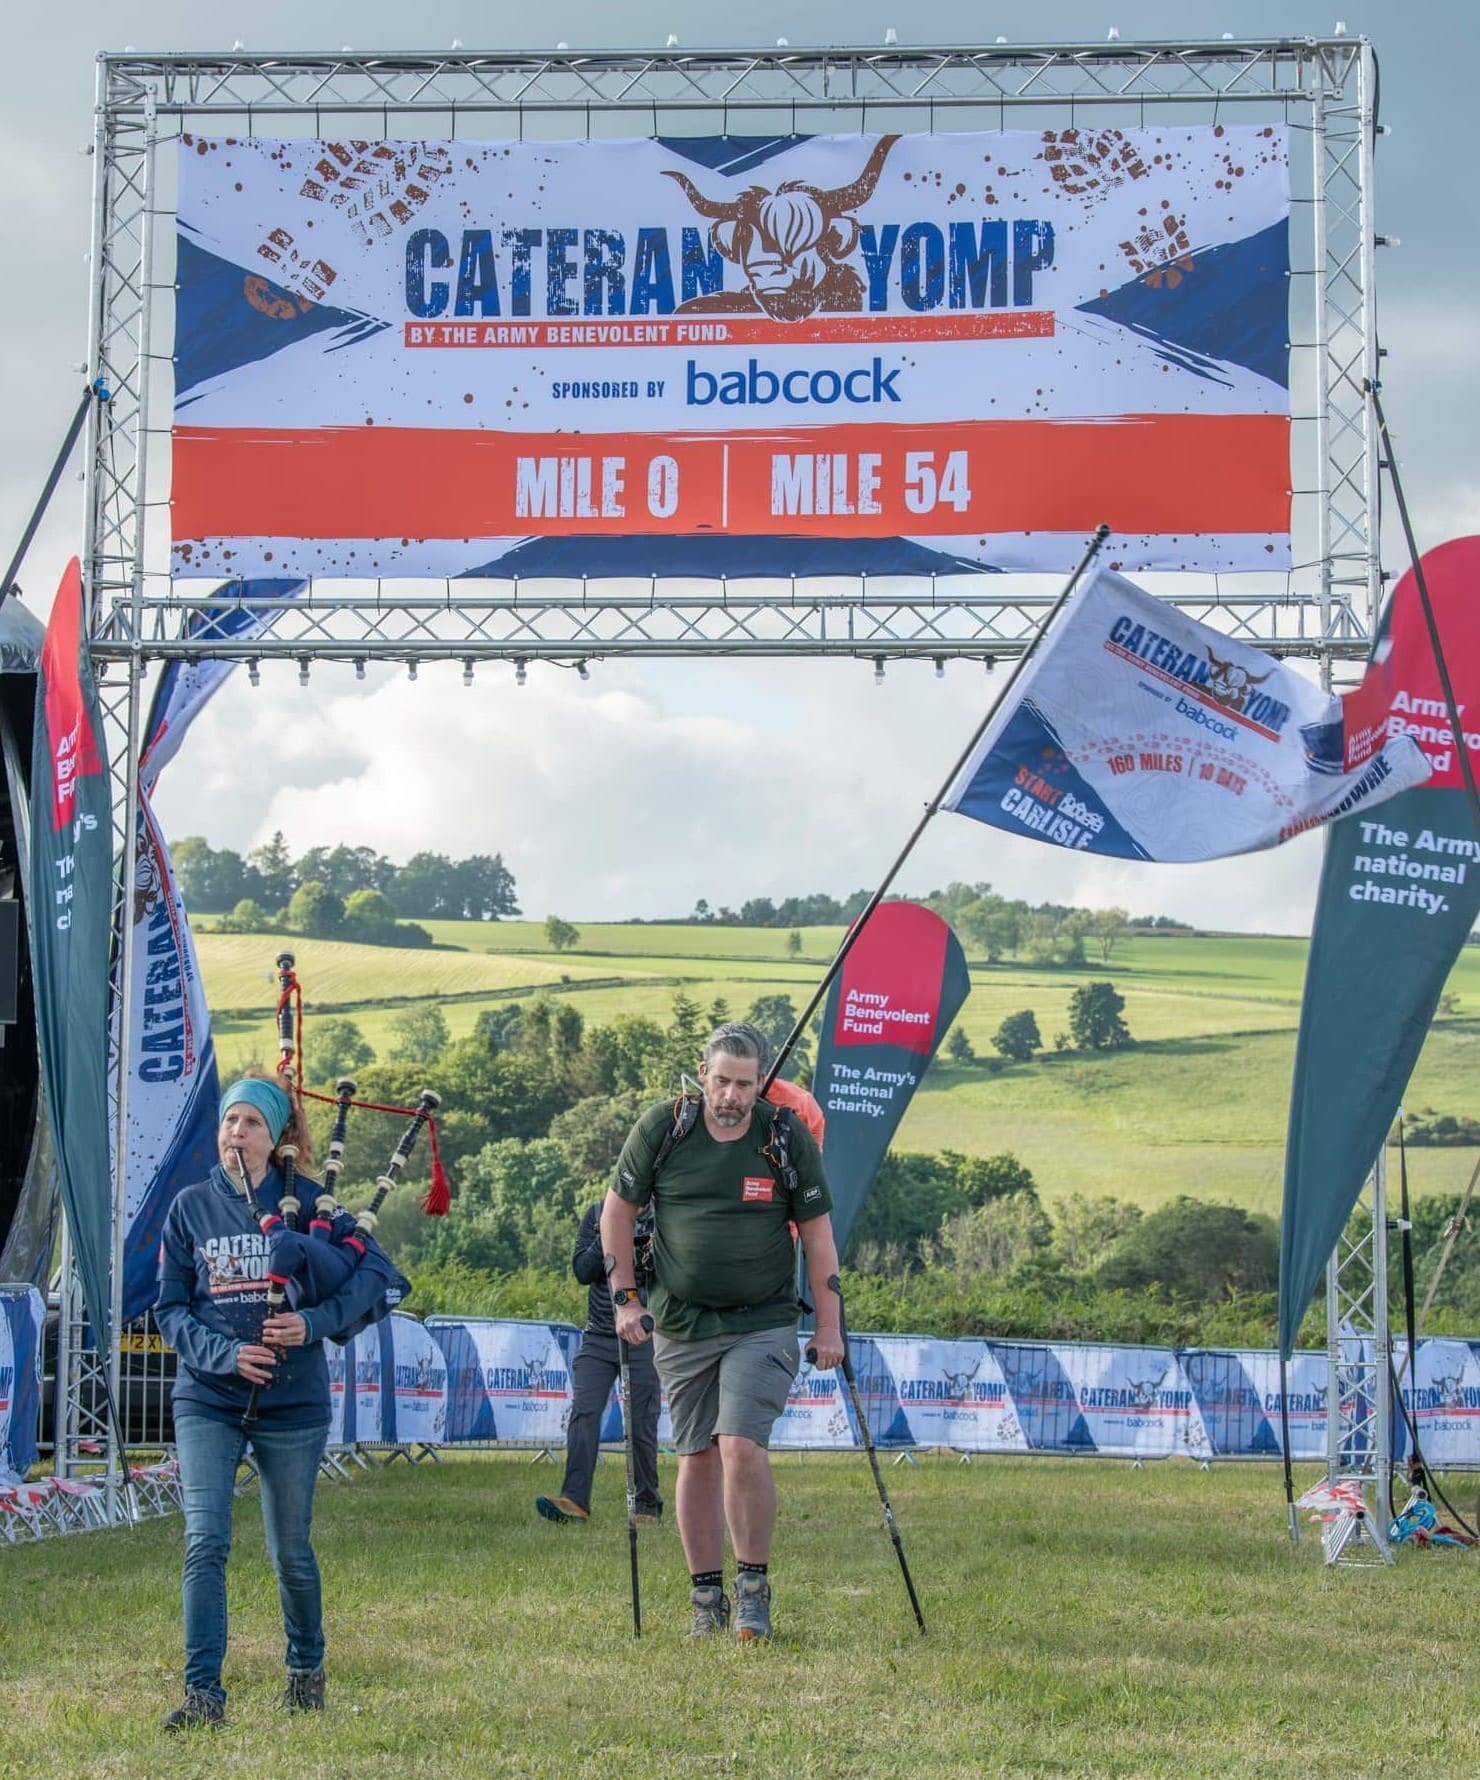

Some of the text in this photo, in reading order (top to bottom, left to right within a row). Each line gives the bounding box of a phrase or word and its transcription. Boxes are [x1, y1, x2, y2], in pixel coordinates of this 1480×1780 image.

[406, 219, 1054, 318] CATERAN YOMP
[411, 324, 727, 343] BY THE ARMY BENEVOLENT FUND
[552, 380, 665, 399] SPONSORED BY
[686, 357, 901, 405] babcock
[515, 454, 679, 518] MILE 0
[771, 450, 971, 516] MILE 54
[1109, 615, 1210, 684] CATERAN
[1175, 698, 1239, 741] babcock
[1108, 752, 1182, 776] 160 MILES
[1200, 763, 1213, 780] 10
[1014, 768, 1063, 805] START
[1000, 788, 1094, 849] CARLISLE
[1360, 822, 1408, 847] The
[1354, 855, 1466, 885] national
[1350, 881, 1450, 915] charity.
[847, 989, 889, 1007] Army
[845, 1004, 930, 1024] Benevolent
[843, 1019, 883, 1035] Fund
[832, 1064, 916, 1086] The Army's
[830, 1082, 893, 1099] national
[828, 1098, 885, 1117] charity.
[206, 1234, 271, 1256] CATERA
[487, 1368, 529, 1390] CATERAN
[545, 1370, 568, 1391] YOMP
[807, 1378, 837, 1398] YOMP
[900, 1380, 951, 1400] CATERAN
[973, 1382, 1006, 1402] YOMP
[1080, 1387, 1136, 1407] CATERAN
[1159, 1389, 1192, 1409] YOMP
